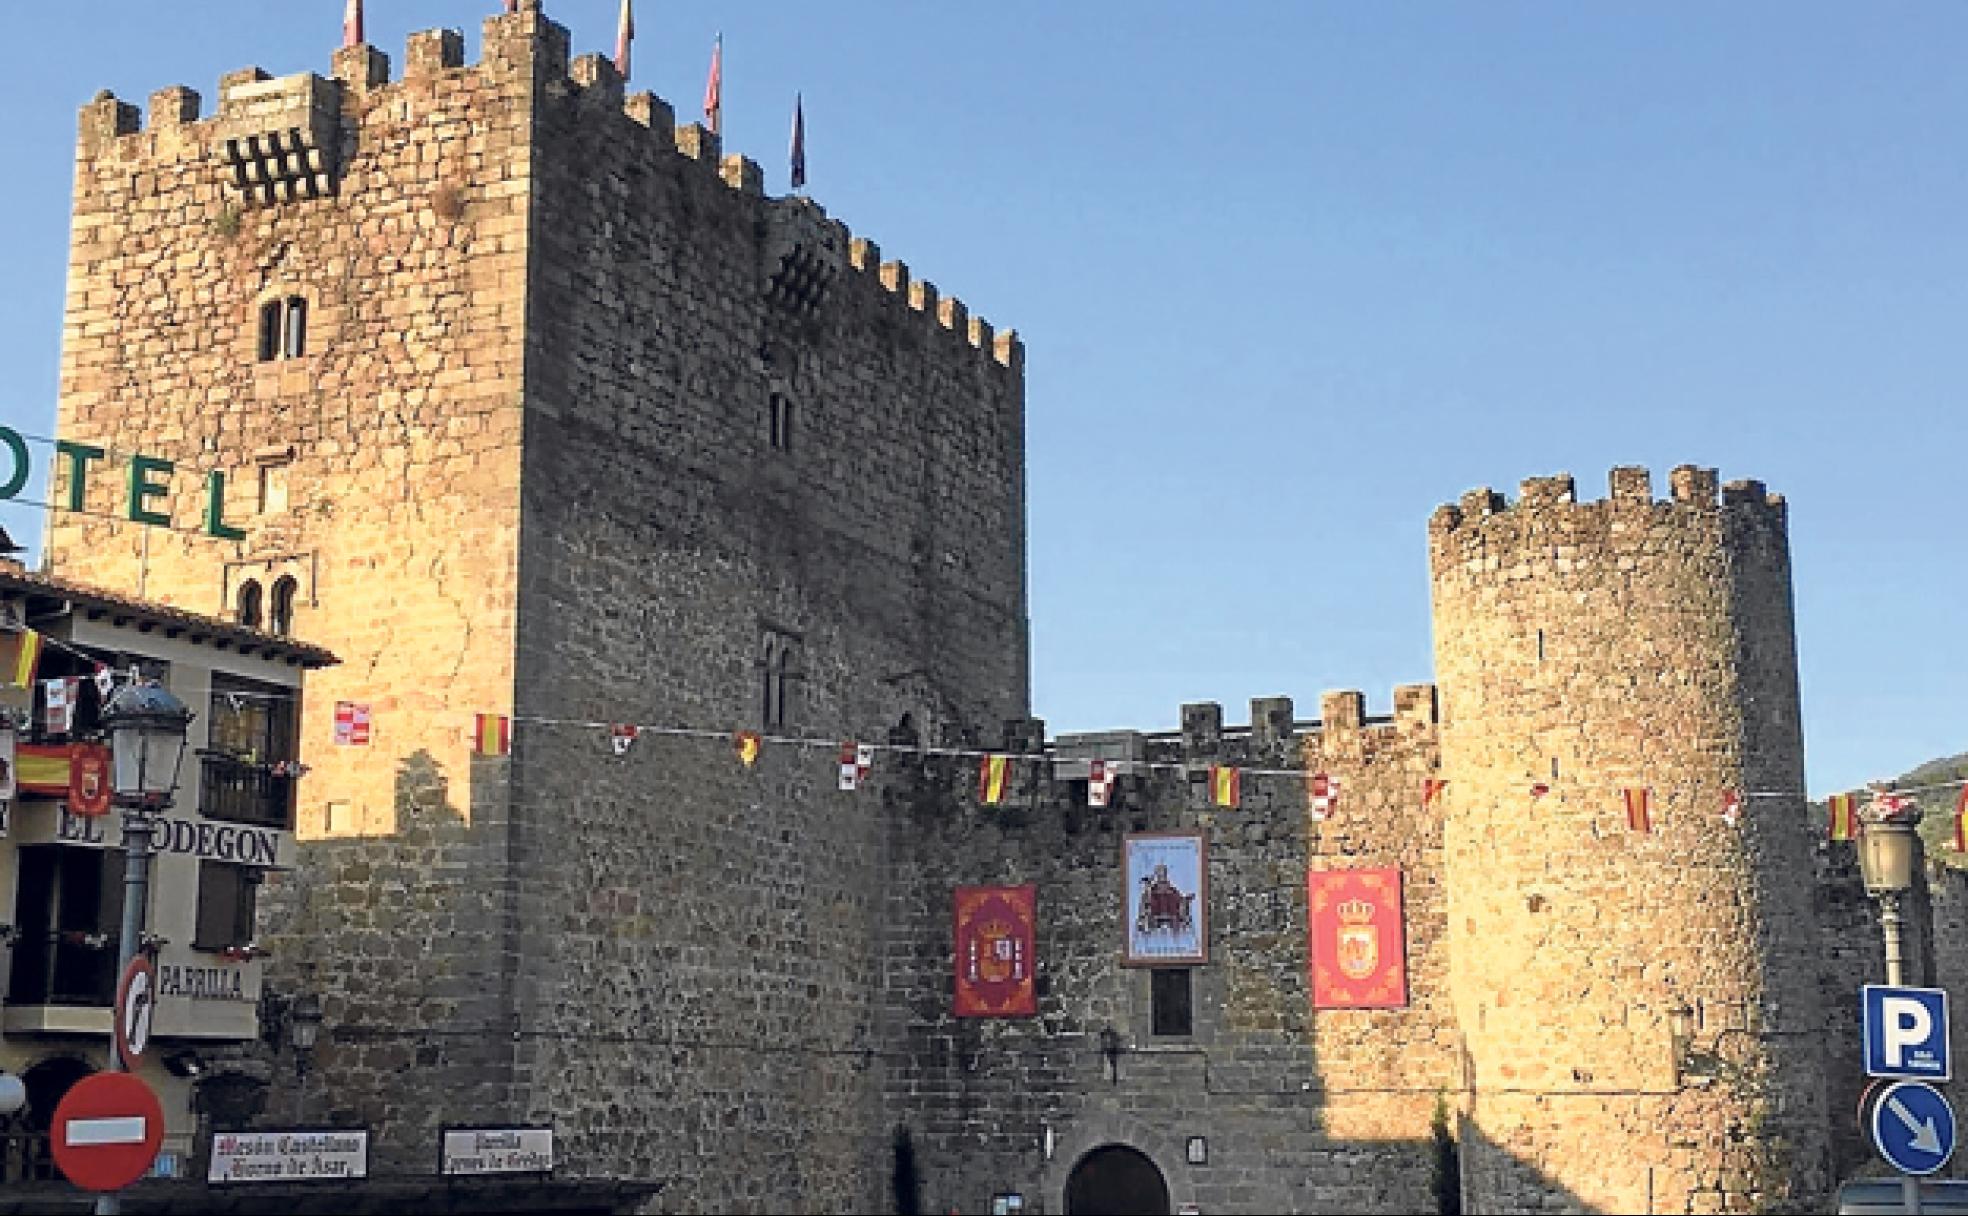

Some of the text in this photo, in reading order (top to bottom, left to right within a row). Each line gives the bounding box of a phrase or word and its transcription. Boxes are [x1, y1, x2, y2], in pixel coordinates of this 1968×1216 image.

[58, 802, 105, 843] EL
[121, 814, 279, 865] ODEGON
[160, 965, 243, 998] PARRILLA
[1882, 997, 1933, 1068] P
[277, 1135, 360, 1155] Castellano
[286, 1157, 307, 1175] de
